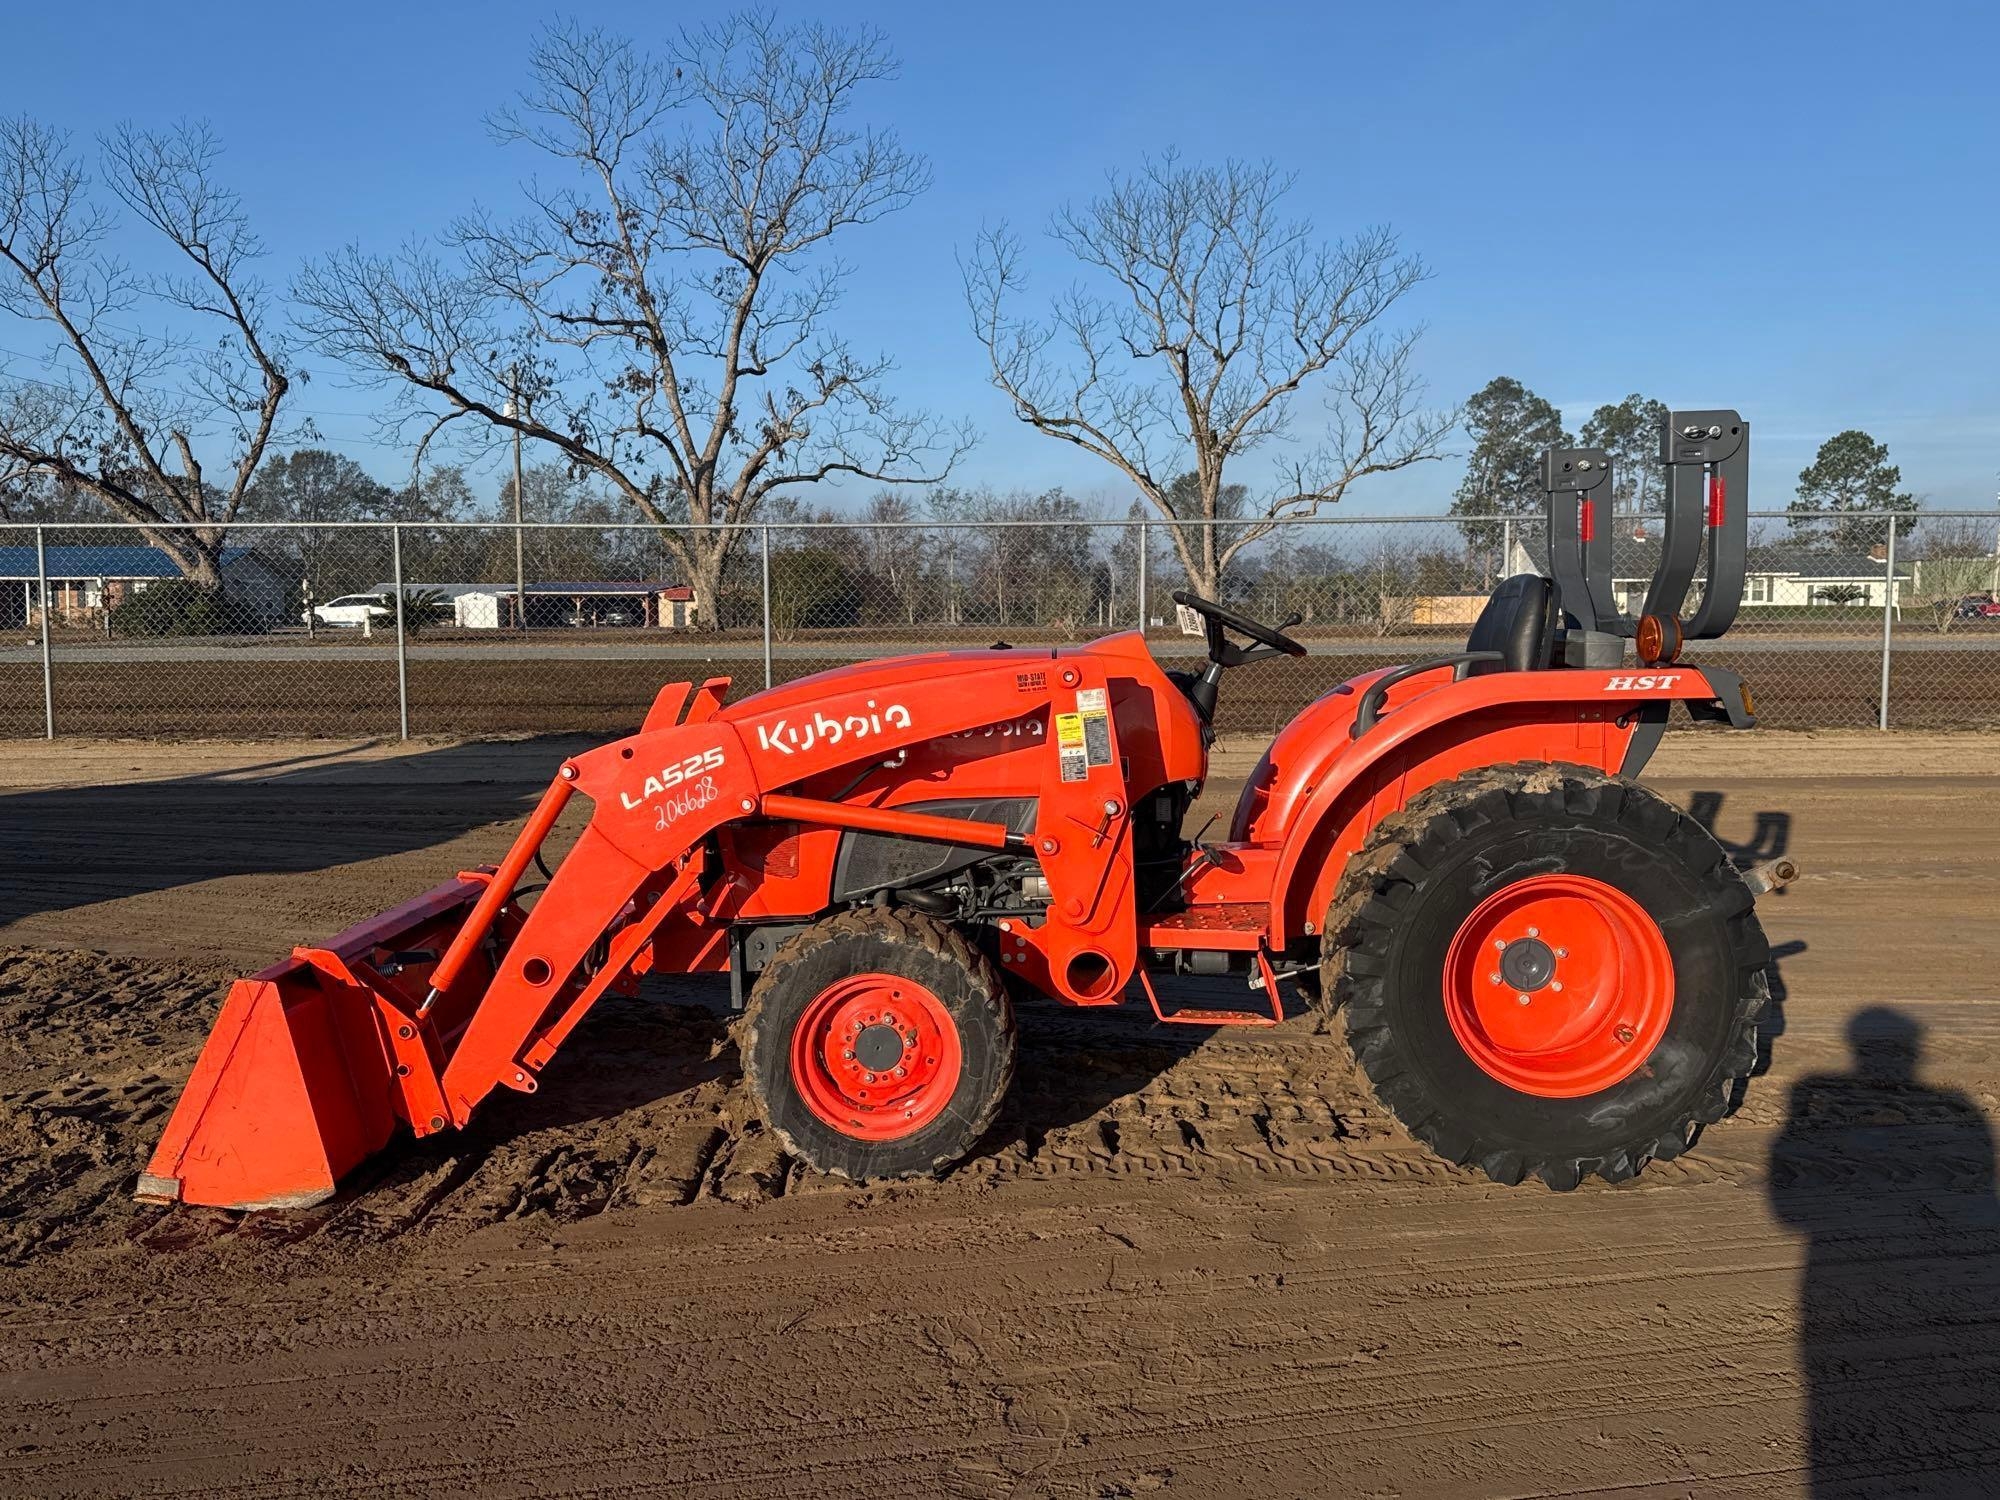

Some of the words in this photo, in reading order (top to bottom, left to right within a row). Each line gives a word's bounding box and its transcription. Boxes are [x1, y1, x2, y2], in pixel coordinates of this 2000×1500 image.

[1603, 675, 1682, 691] HST
[620, 745, 725, 810] LA525
[653, 775, 719, 831] 206628
